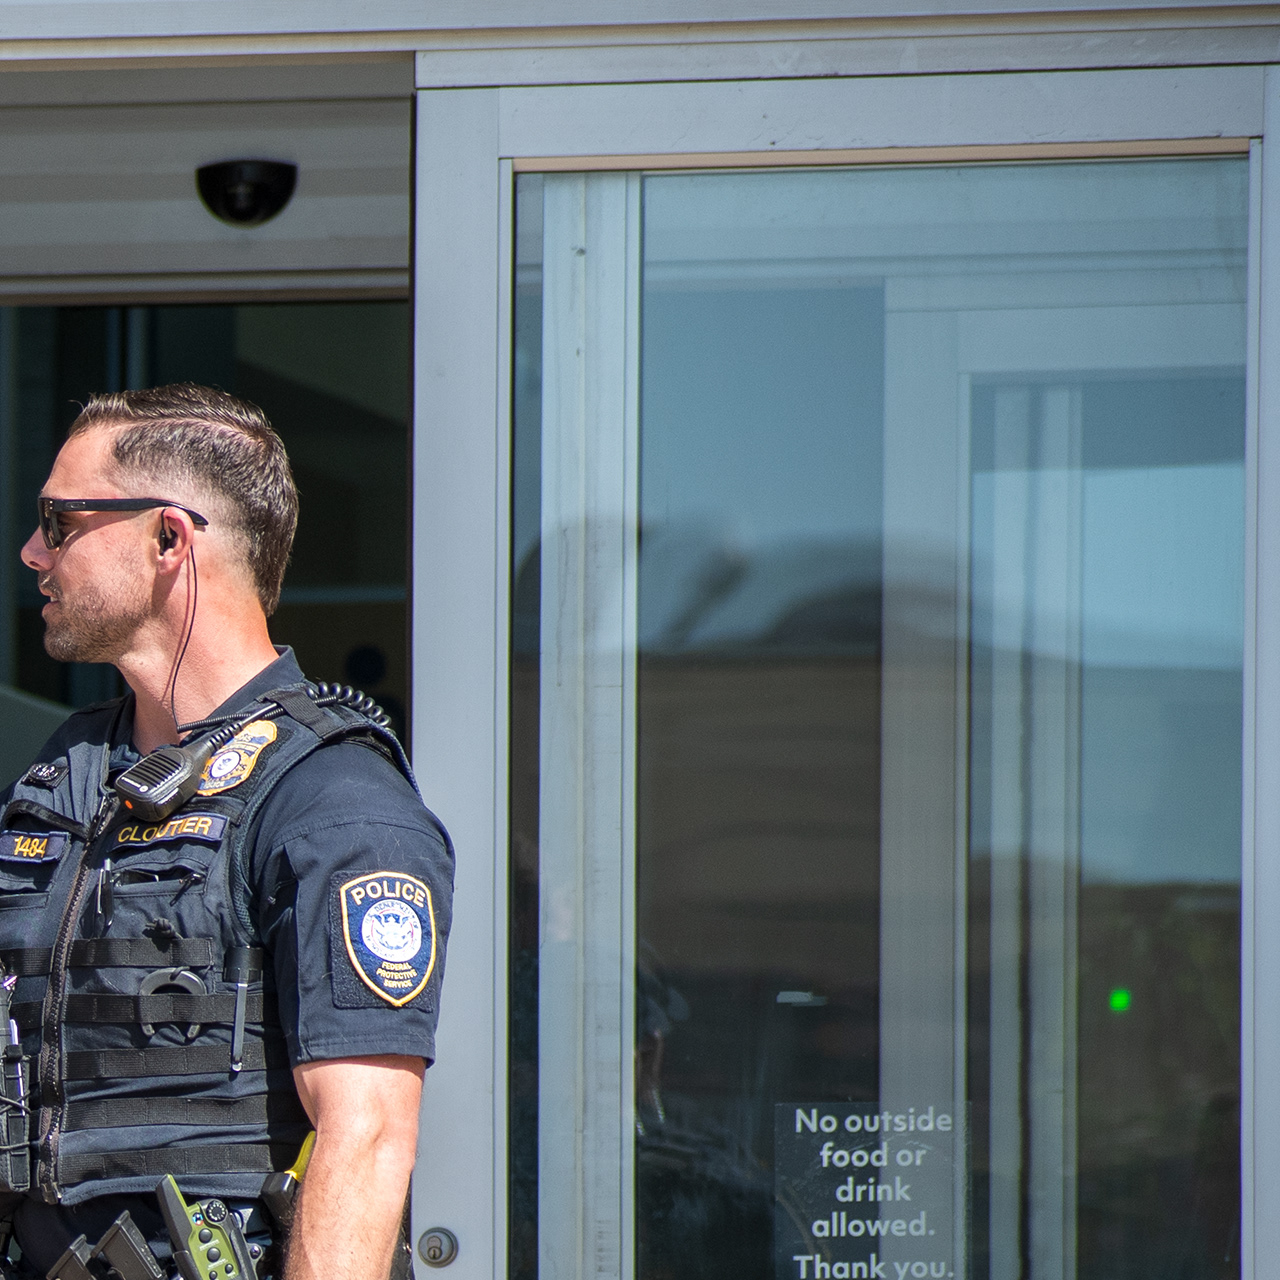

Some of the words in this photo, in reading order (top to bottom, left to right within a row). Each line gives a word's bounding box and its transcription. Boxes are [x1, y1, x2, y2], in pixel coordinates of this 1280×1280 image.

[117, 815, 213, 843] CLOUTIER
[14, 835, 46, 858] 1484
[350, 880, 426, 908] POLICE
[376, 968, 418, 980] PROTECTIVE
[381, 961, 412, 971] FEDERAL
[383, 979, 413, 989] SERVICE
[795, 1108, 838, 1133] No
[844, 1106, 952, 1133] outside
[819, 1141, 889, 1168] food
[895, 1149, 927, 1167] or
[835, 1176, 912, 1203] drink
[811, 1211, 936, 1238] allowed.
[793, 1253, 887, 1280] Thank
